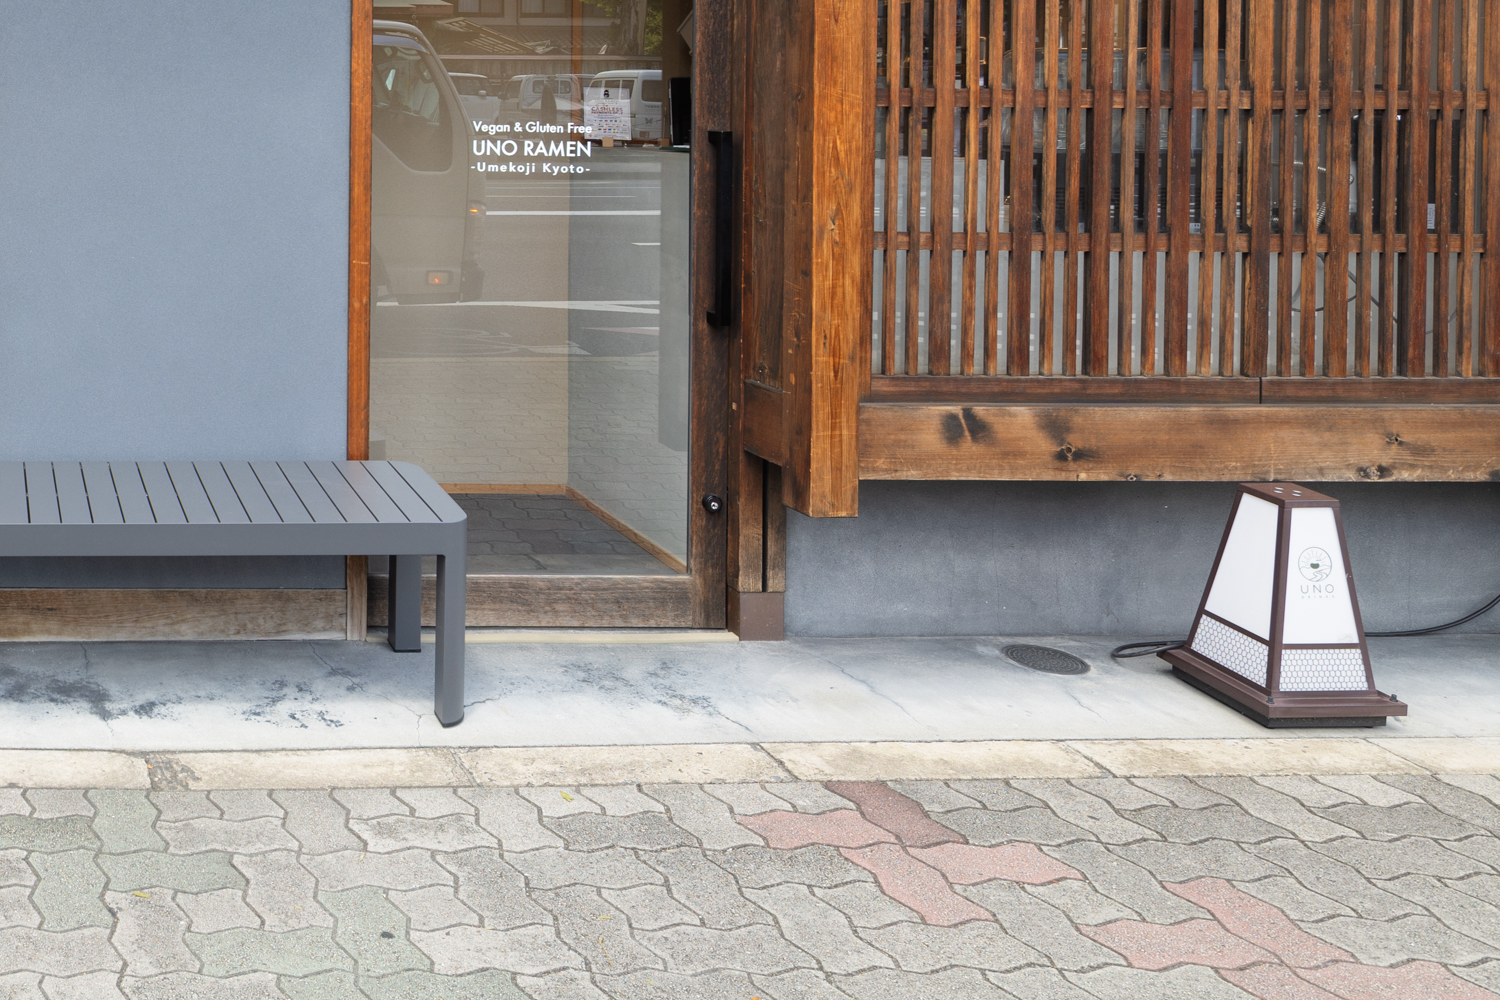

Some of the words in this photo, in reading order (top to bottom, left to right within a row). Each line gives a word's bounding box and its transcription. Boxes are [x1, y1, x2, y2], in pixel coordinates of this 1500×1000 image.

[472, 120, 511, 135] Vegan
[513, 121, 523, 132] &
[525, 121, 564, 134] Gluten
[567, 122, 593, 134] Free
[472, 139, 518, 156] UNO
[523, 140, 592, 157] RAMEN
[470, 161, 536, 176] -Umekoji
[542, 162, 591, 176] Kyoto-
[1300, 584, 1335, 595] UNO
